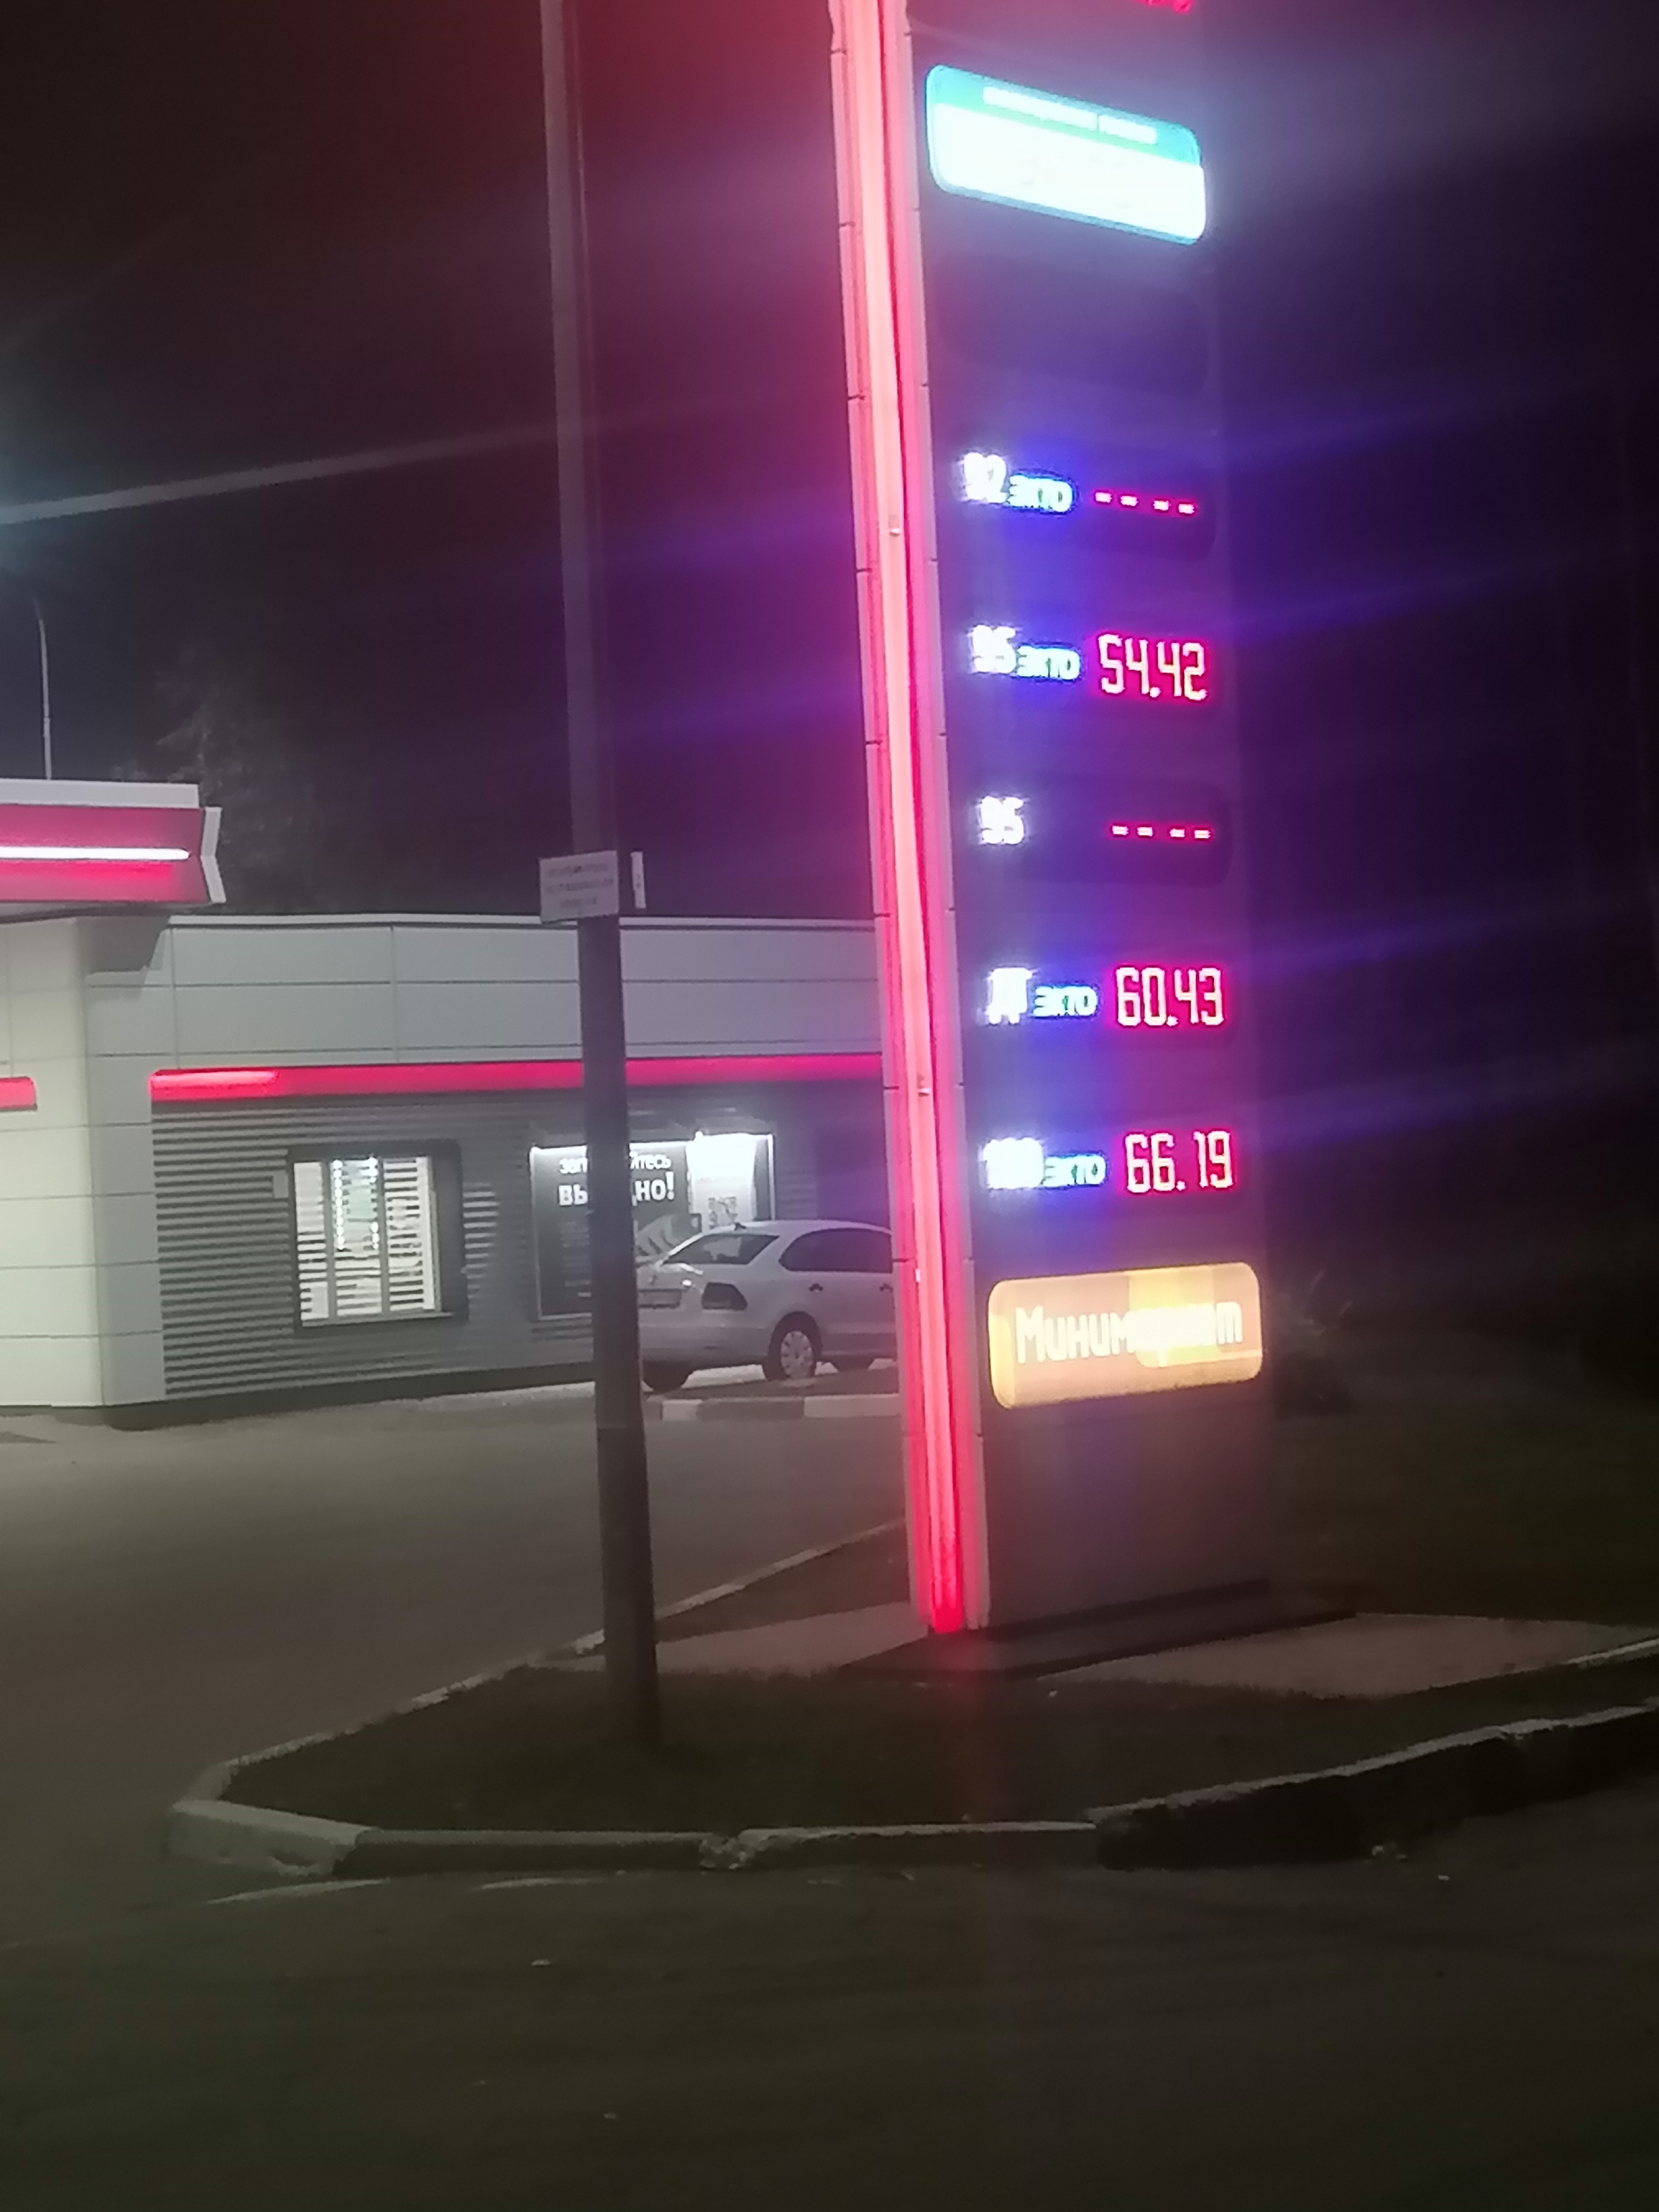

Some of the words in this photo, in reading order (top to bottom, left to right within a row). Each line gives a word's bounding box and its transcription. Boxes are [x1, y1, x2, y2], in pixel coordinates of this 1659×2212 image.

[1098, 634, 1208, 701] 54.42
[1115, 967, 1225, 1027] 60.43
[1125, 1130, 1234, 1194] 66.19
